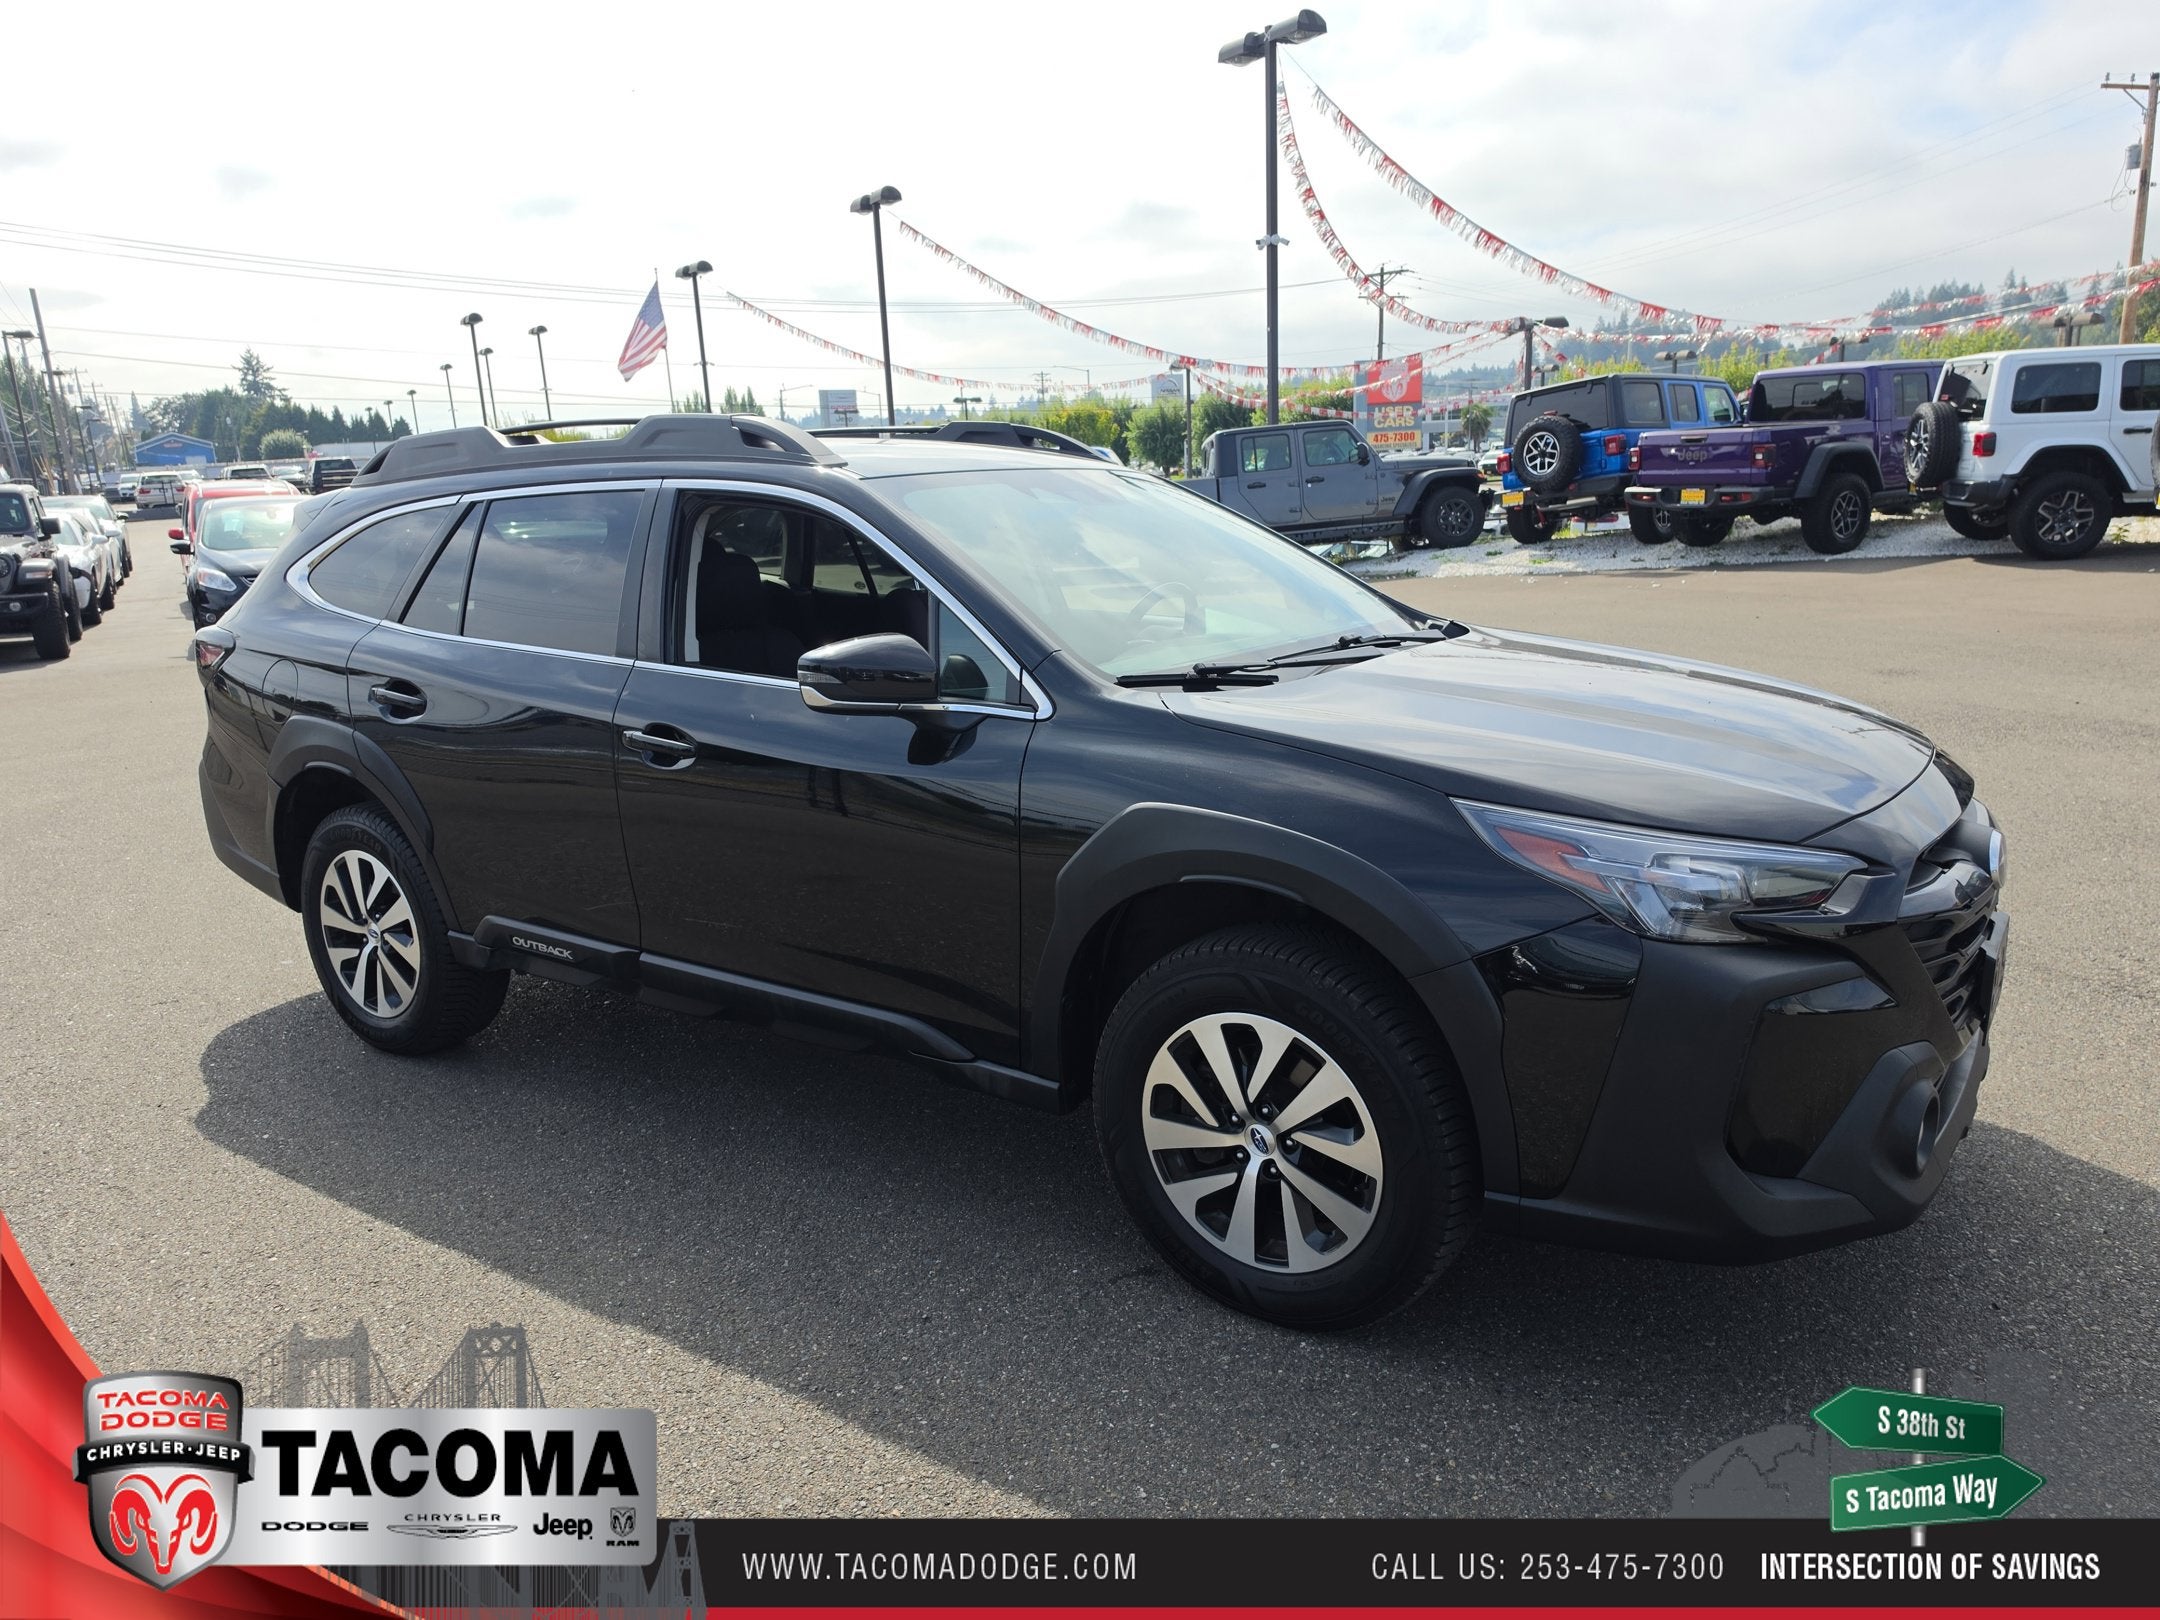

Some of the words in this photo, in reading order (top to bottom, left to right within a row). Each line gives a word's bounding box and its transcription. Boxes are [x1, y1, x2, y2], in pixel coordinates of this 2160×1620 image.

[1374, 417, 1414, 428] CARS
[1373, 432, 1415, 443] 475-7300
[1678, 448, 1707, 463] Jeep
[512, 936, 573, 960] OUTBACK
